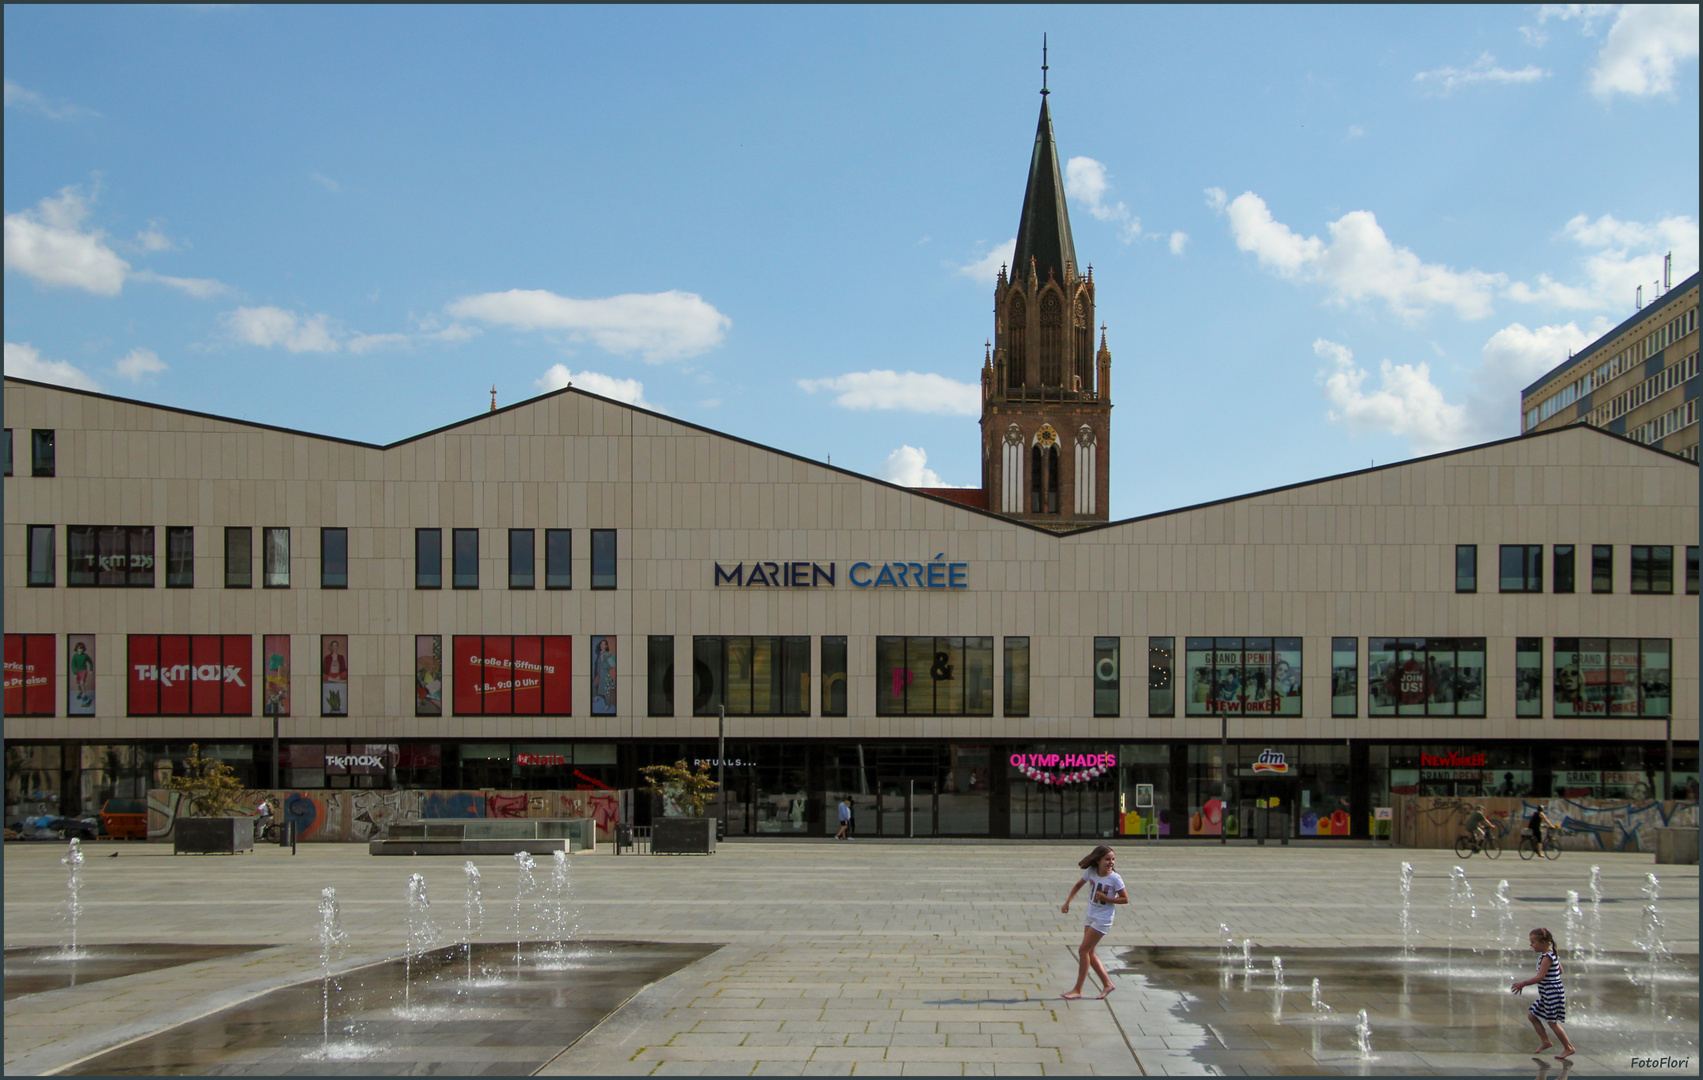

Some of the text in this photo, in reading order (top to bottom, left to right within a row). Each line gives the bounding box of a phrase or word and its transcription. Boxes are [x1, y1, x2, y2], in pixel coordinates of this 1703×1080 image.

[715, 552, 967, 587] MARIEN CARRÉE
[1205, 653, 1236, 664] GRAND
[1572, 654, 1601, 665] GRAND
[4, 661, 35, 671] arken
[470, 655, 555, 674] Große Eröffnung
[11, 675, 47, 686] Preise
[497, 679, 521, 689] 9:00
[523, 678, 539, 687] Uhr
[1400, 674, 1423, 682] JOIN
[1400, 682, 1423, 693] US!
[529, 753, 565, 765] Nails
[1259, 749, 1284, 764] dm
[1420, 771, 1450, 781] GRAND
[1566, 772, 1597, 782] GRAND
